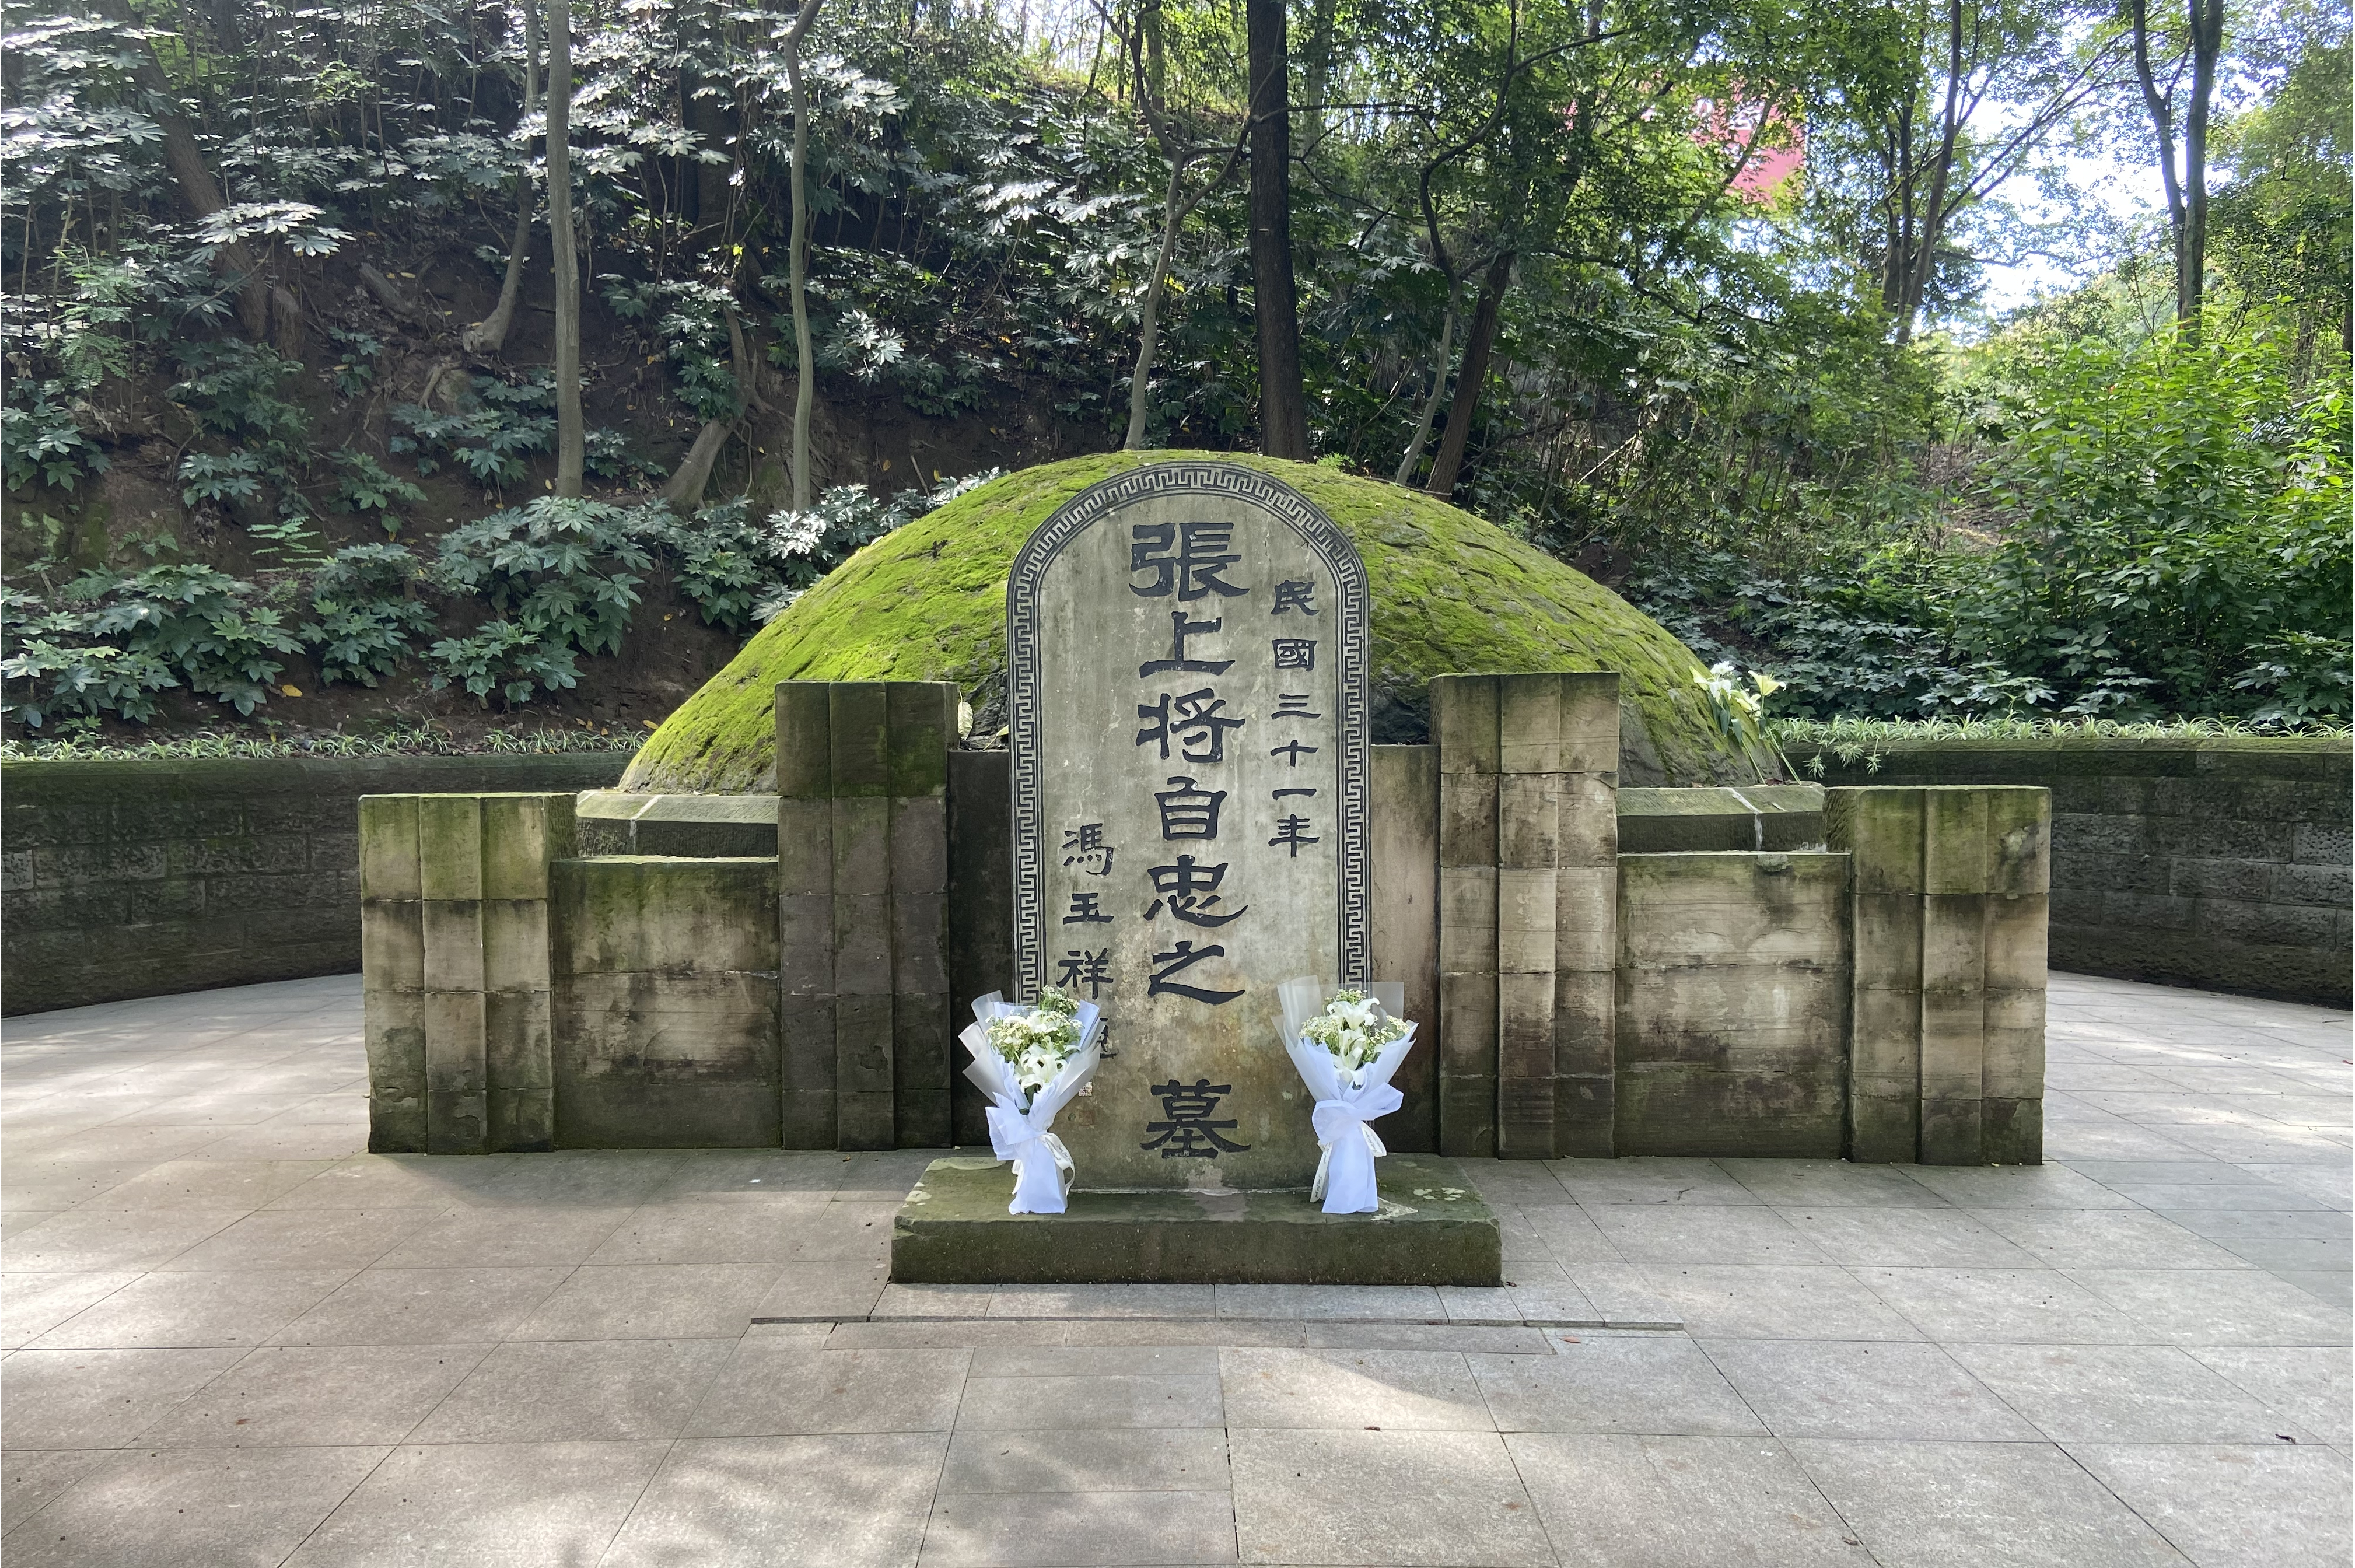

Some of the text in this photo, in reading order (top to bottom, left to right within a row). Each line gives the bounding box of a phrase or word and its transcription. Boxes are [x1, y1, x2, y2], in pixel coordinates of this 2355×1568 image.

[1267, 579, 1322, 859] 民國三十一年
